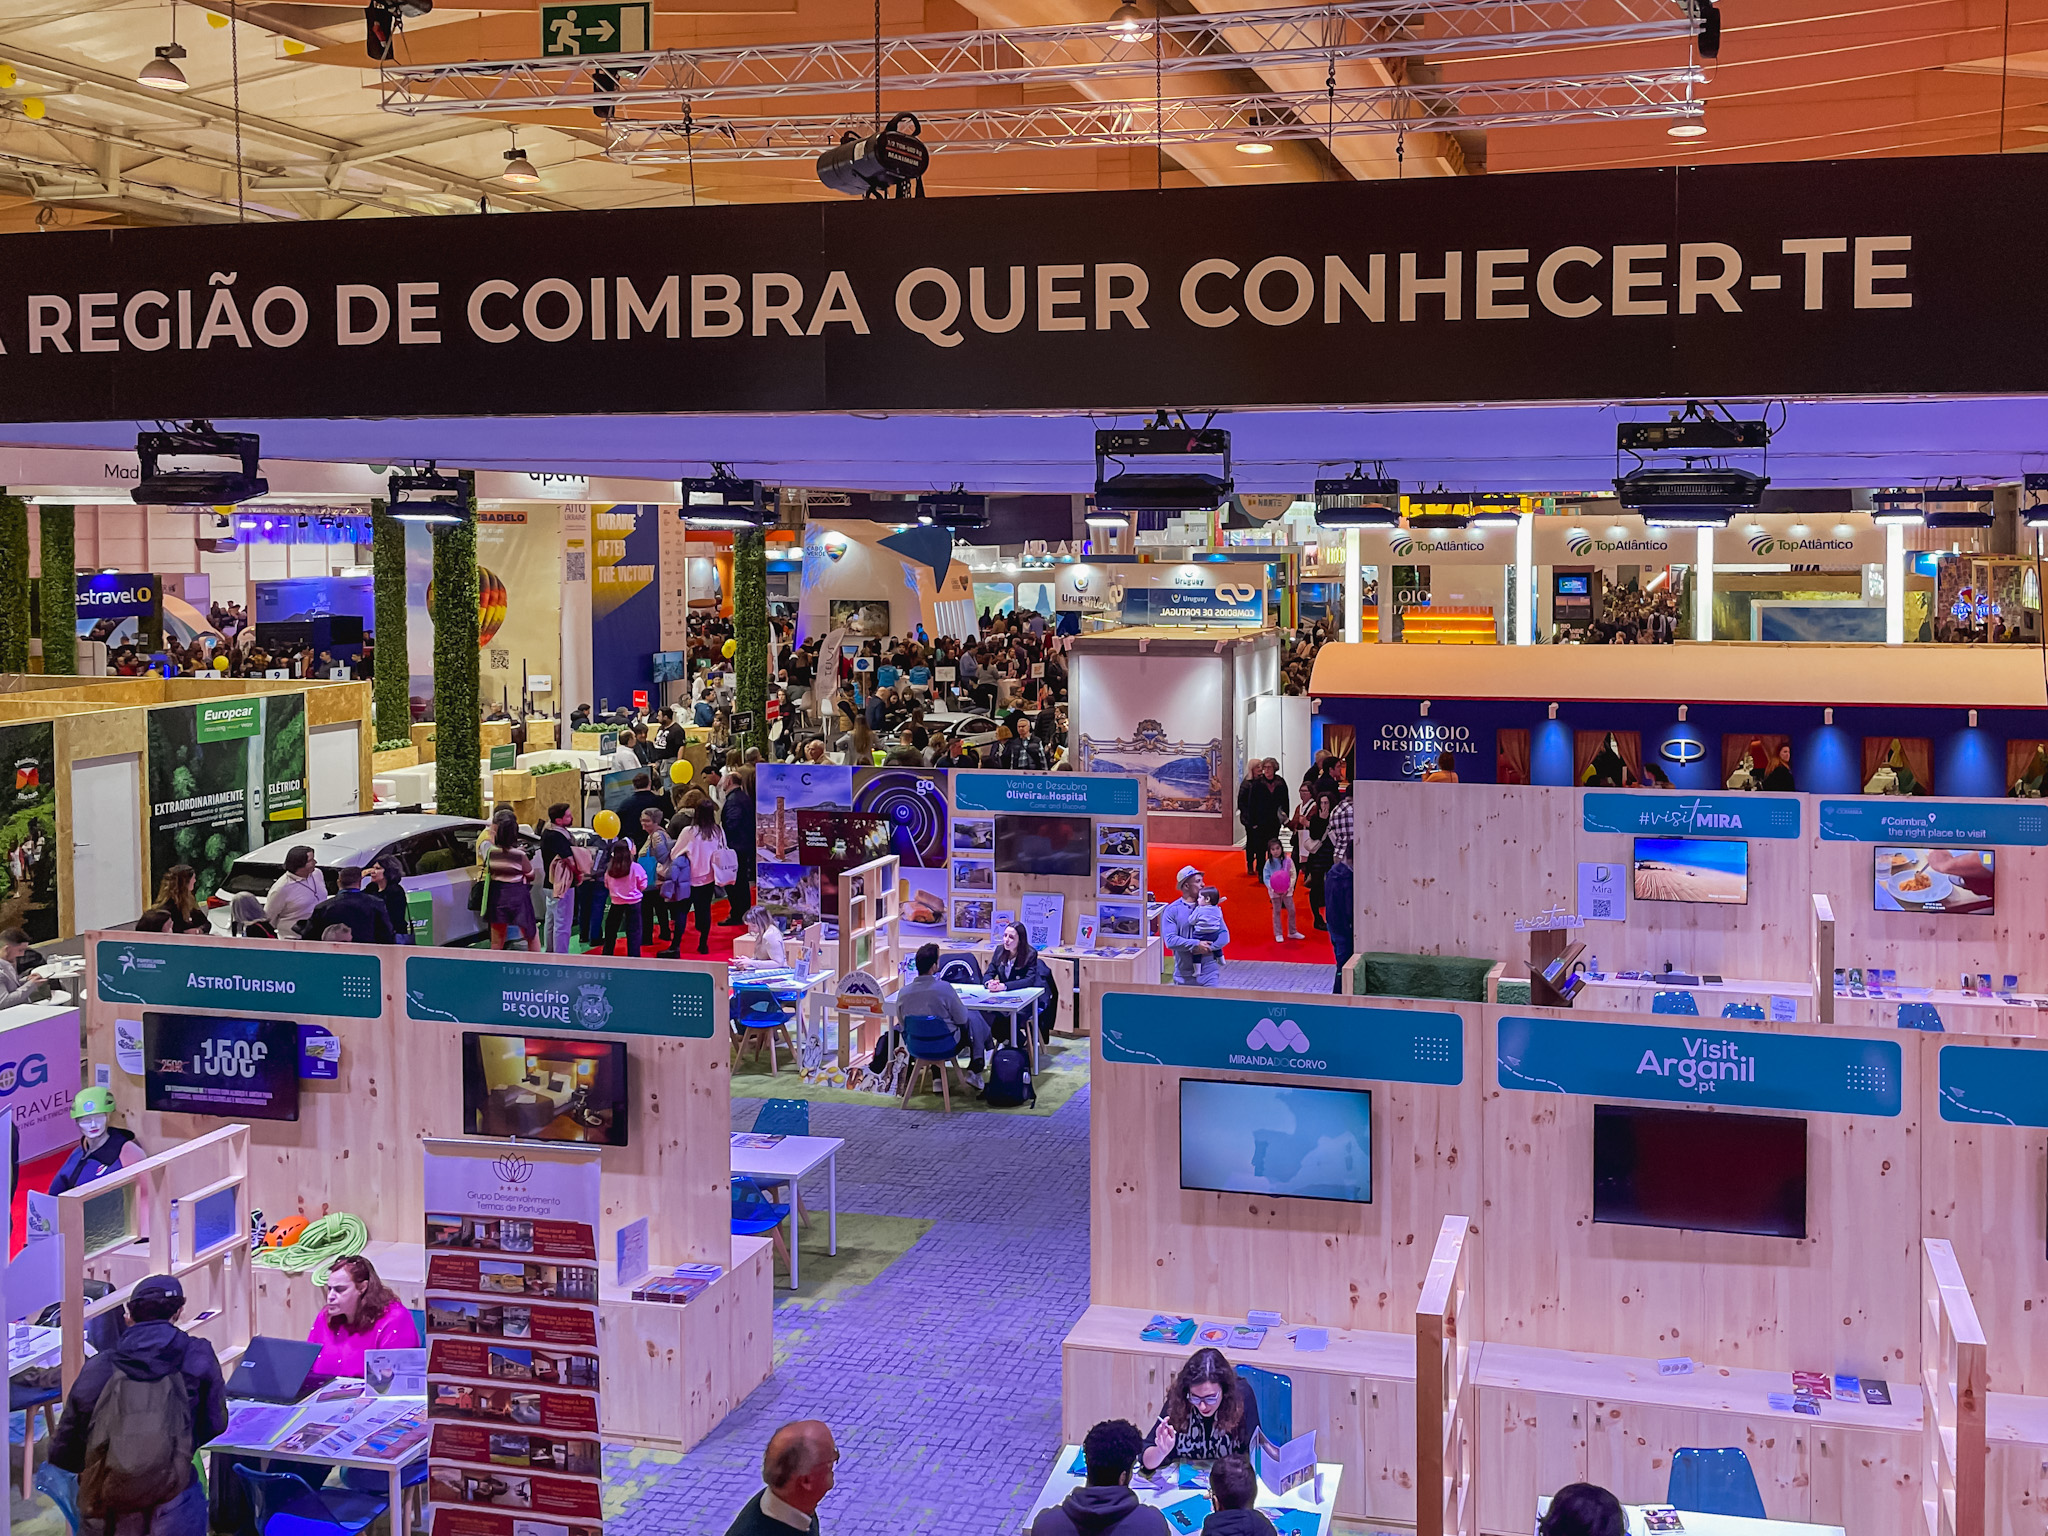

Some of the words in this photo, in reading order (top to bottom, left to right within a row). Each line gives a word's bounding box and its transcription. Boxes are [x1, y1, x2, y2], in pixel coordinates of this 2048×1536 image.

[888, 152, 919, 167] MAXIMUM
[28, 272, 309, 353] REGIÃO
[336, 282, 441, 346] DE
[467, 271, 870, 343] COIMBRA
[895, 262, 1150, 347] QUER
[1180, 236, 1912, 328] CONHECER-TE
[597, 513, 636, 530] UKRAINE
[598, 540, 626, 557] AFTER
[598, 566, 616, 582] THE
[617, 565, 655, 582] VICTORY
[1175, 579, 1203, 587] Uruguay
[1062, 594, 1100, 604] Uruguay
[1183, 596, 1208, 604] Uruguay
[274, 671, 280, 679] 9
[337, 669, 342, 677] 8
[204, 707, 253, 721] Europcar
[1381, 724, 1470, 740] COMBOIO
[1373, 739, 1478, 754] PRESIDENCIAL
[268, 780, 300, 795] ELÉTRICO
[916, 778, 935, 795] go
[1046, 781, 1087, 791] Descubra
[154, 789, 244, 816] EXTRAORDINARIAMENTE
[1029, 801, 1046, 809] Come
[1889, 827, 1904, 837] the
[1905, 827, 1927, 839] right
[1928, 828, 1954, 839] place
[1956, 829, 1965, 838] to
[1967, 829, 1986, 838] visit
[1592, 885, 1612, 893] Mira
[502, 966, 550, 977] TURISMO
[557, 969, 570, 979] DE
[577, 970, 612, 980] SOURE
[502, 1003, 517, 1013] DE
[519, 1005, 571, 1024] SOURE
[1268, 1007, 1287, 1017] VISIT
[1683, 1036, 1739, 1061] Visit
[1636, 1050, 1755, 1088] Arganil
[1695, 1080, 1715, 1093] .pt
[467, 1191, 492, 1201] Grupo
[494, 1193, 561, 1206] Desenvolvimento
[477, 1201, 504, 1211] Termas
[506, 1204, 516, 1212] de
[518, 1205, 551, 1215] Portugal
